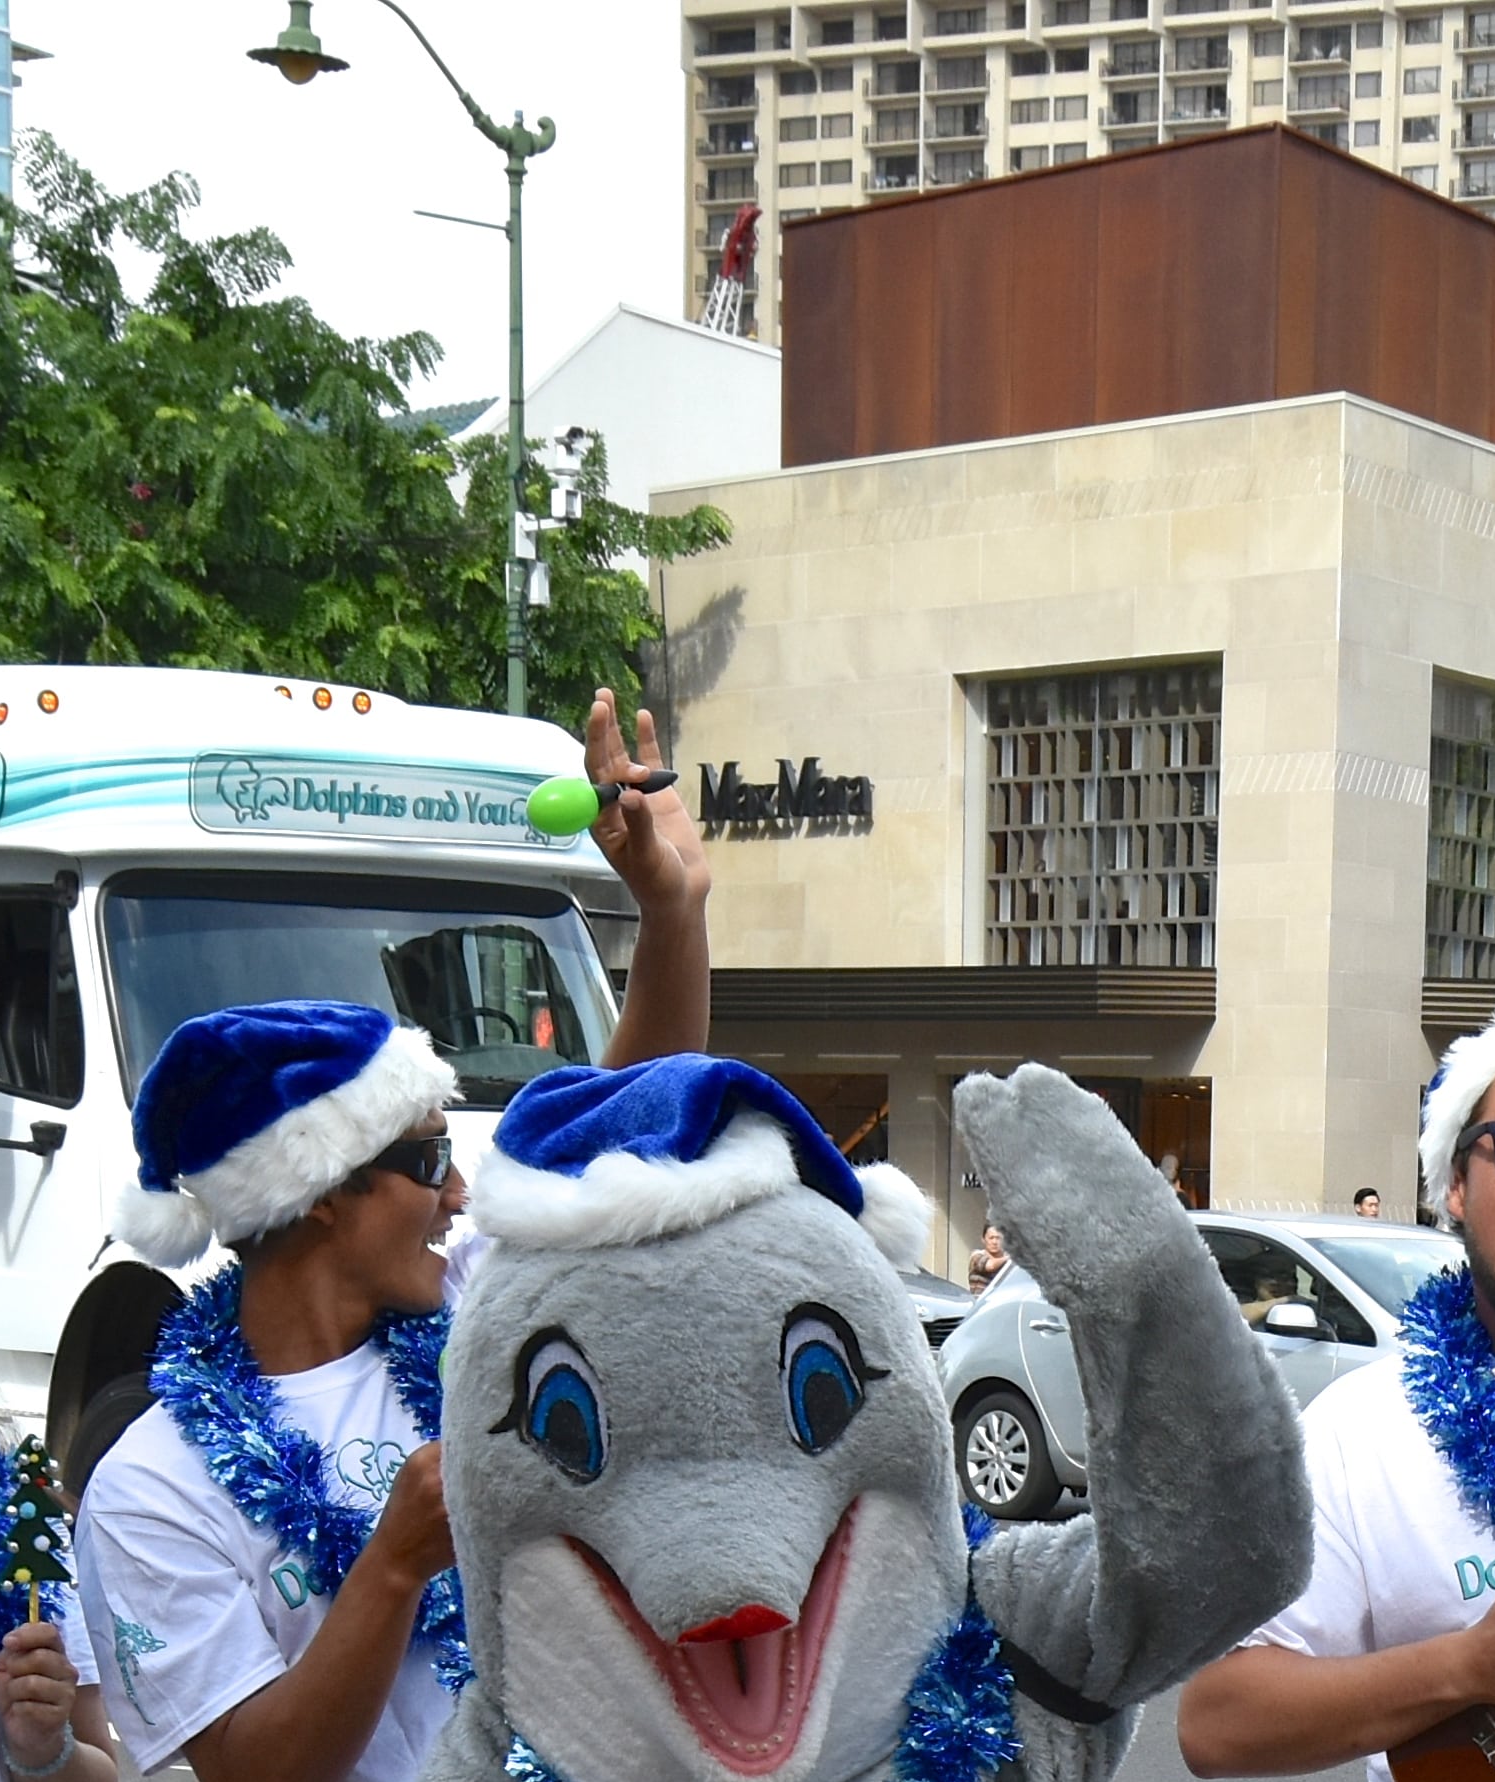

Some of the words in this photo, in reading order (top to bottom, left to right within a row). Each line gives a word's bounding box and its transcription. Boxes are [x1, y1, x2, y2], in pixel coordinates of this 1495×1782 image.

[293, 777, 407, 824] Dolphins
[412, 790, 459, 824] and
[464, 790, 511, 827] You
